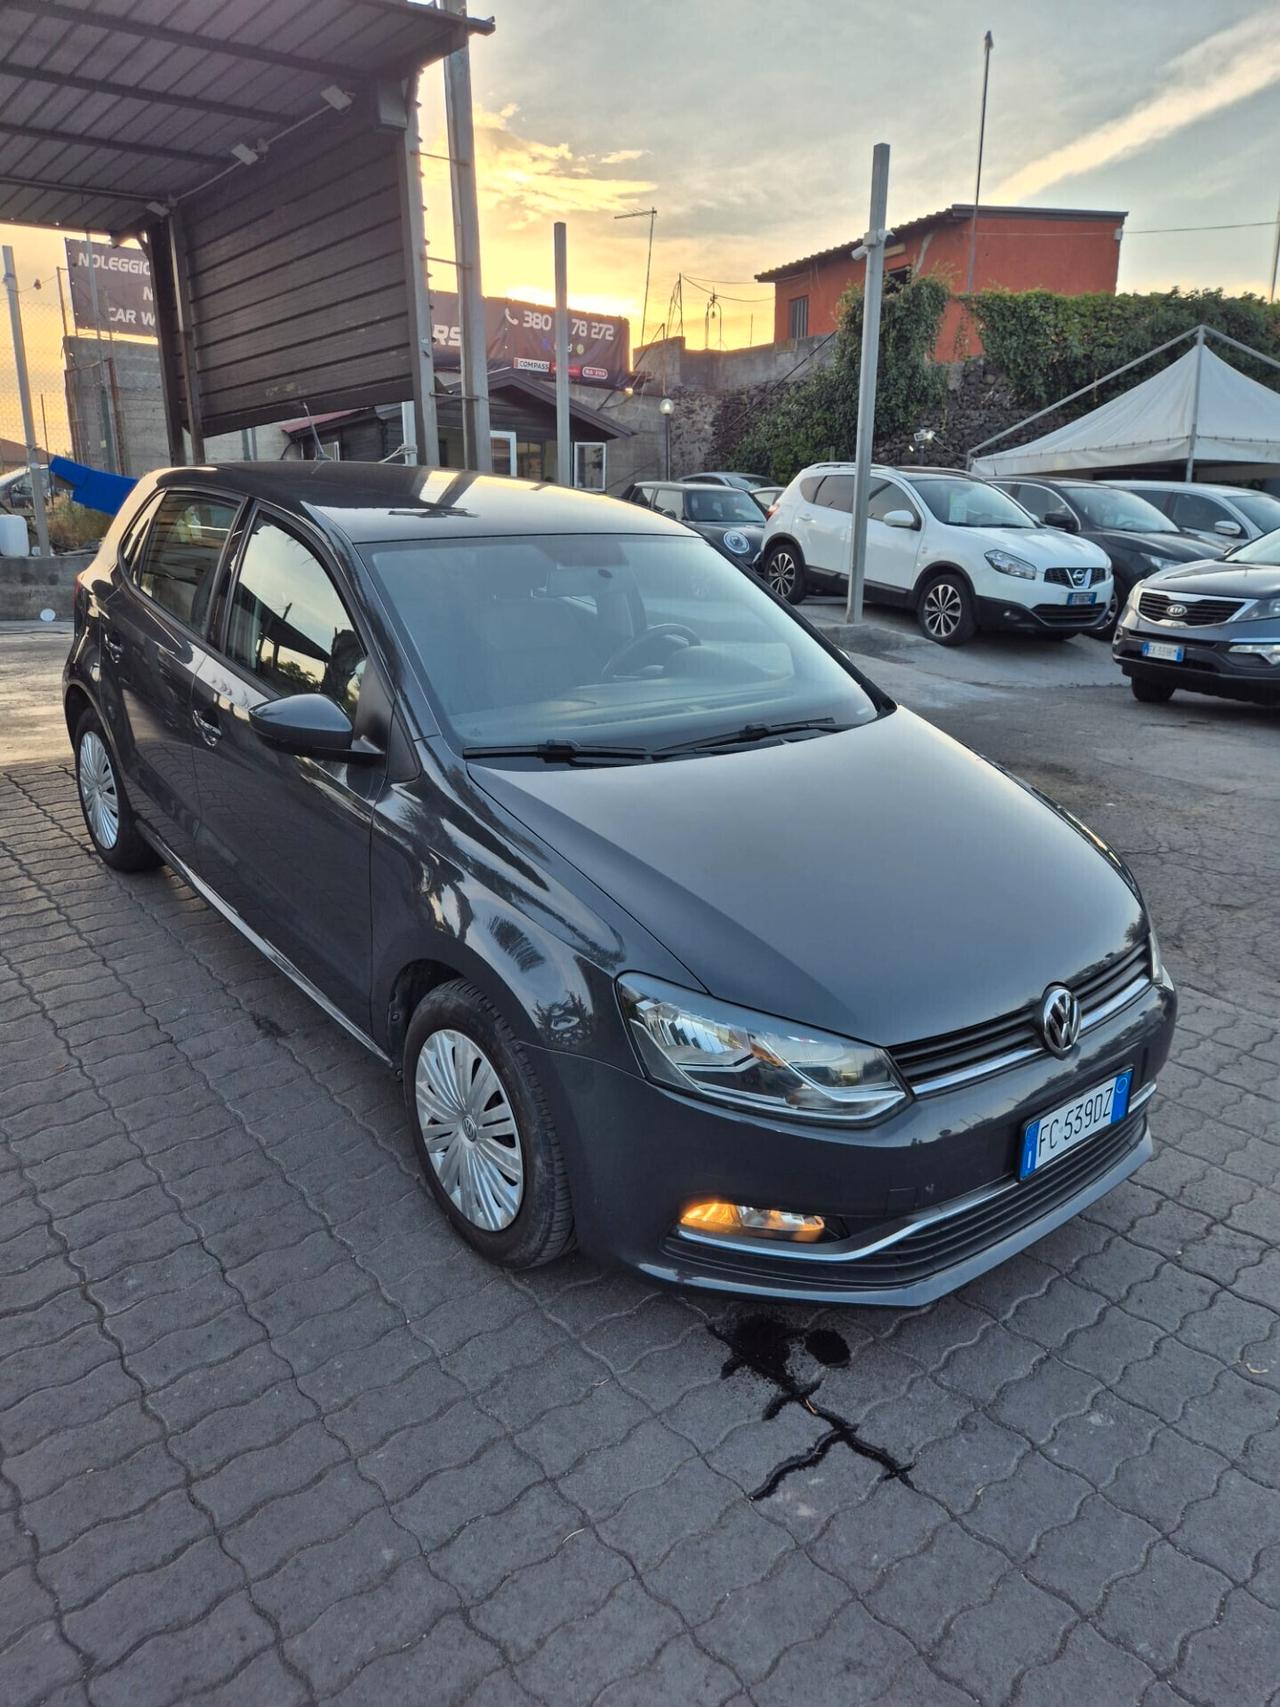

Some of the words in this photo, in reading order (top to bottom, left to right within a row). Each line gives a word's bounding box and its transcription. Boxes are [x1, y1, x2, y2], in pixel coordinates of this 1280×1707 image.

[522, 310, 552, 331] 380
[591, 321, 615, 341] 272
[519, 360, 549, 370] COMPASS
